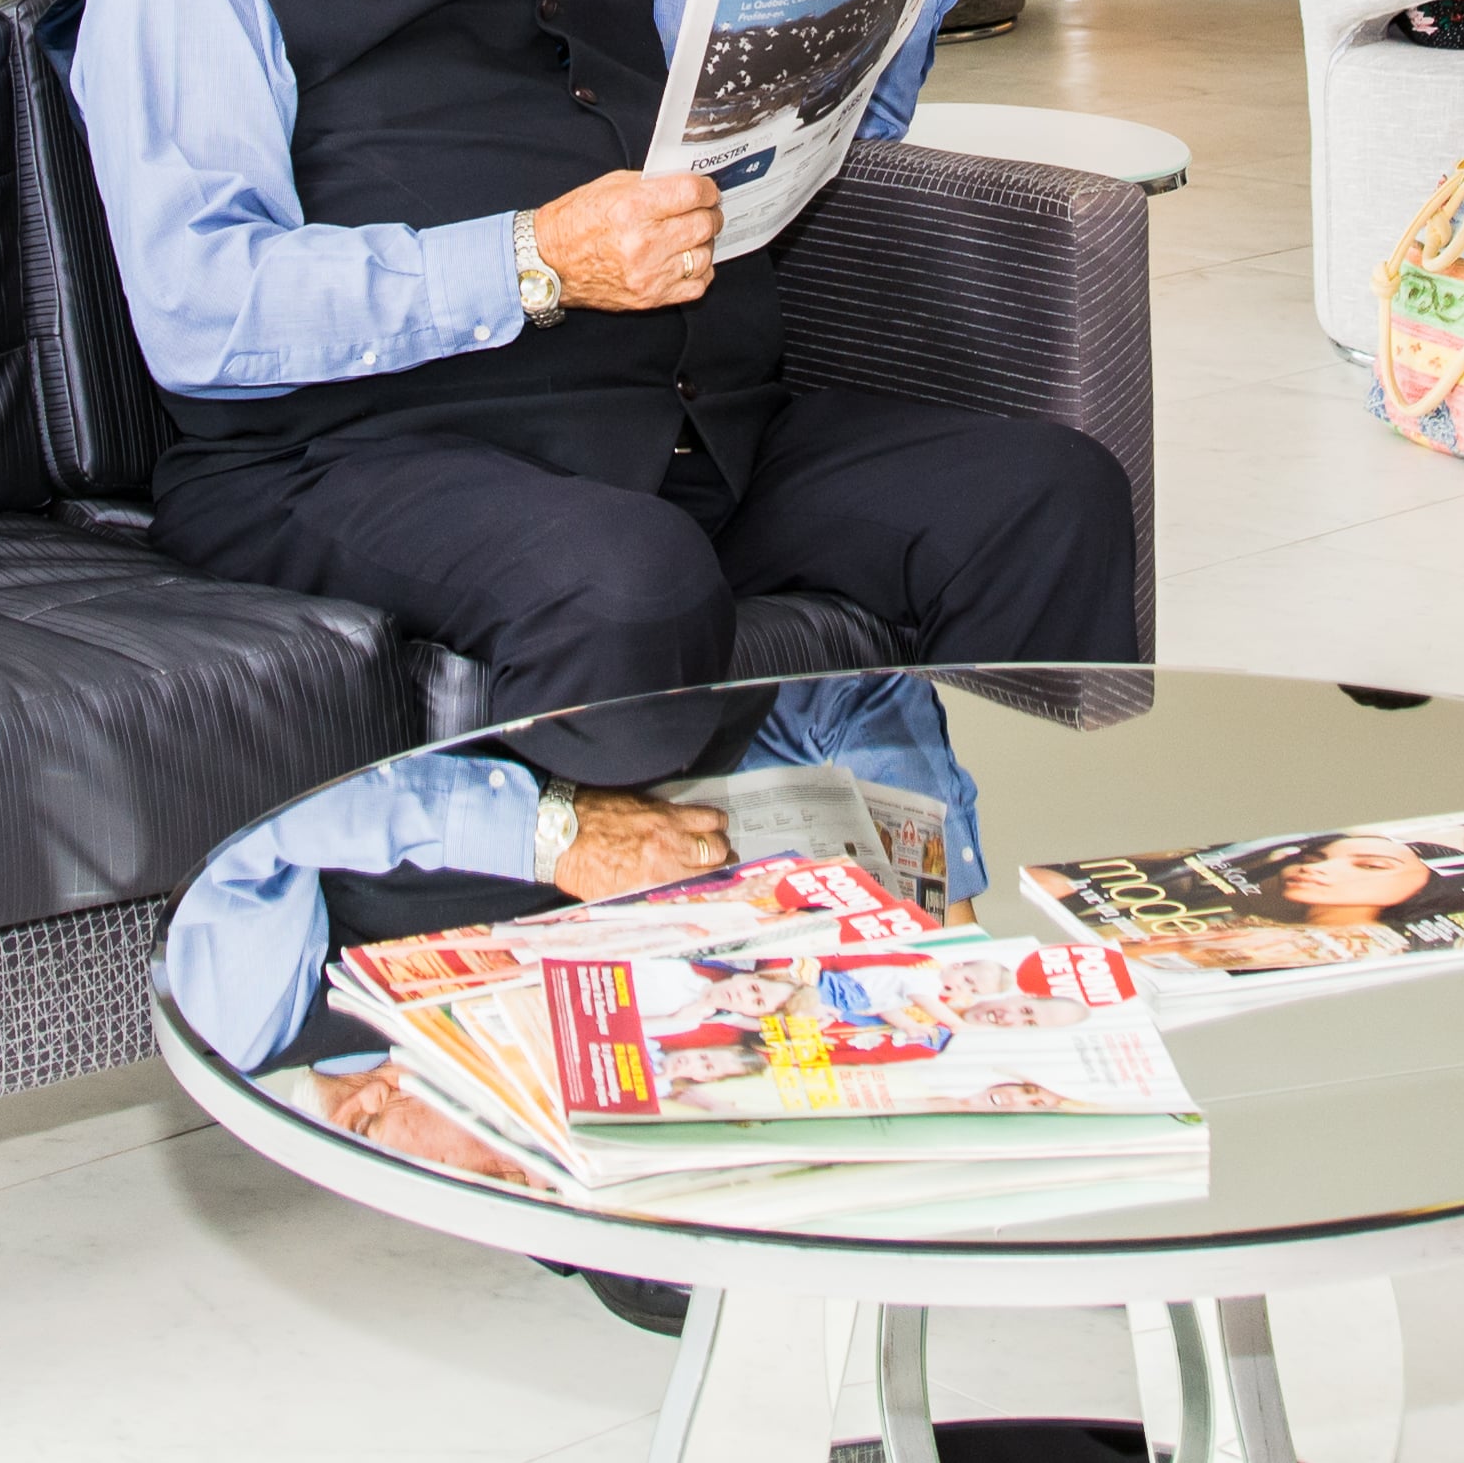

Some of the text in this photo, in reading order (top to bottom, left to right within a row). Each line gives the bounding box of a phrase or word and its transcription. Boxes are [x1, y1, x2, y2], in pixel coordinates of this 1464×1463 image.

[690, 142, 749, 171] FORESTER
[813, 865, 883, 909] POIN
[1079, 858, 1233, 935] mode
[1038, 946, 1086, 1002] DE VU
[1070, 945, 1124, 1005] POINT
